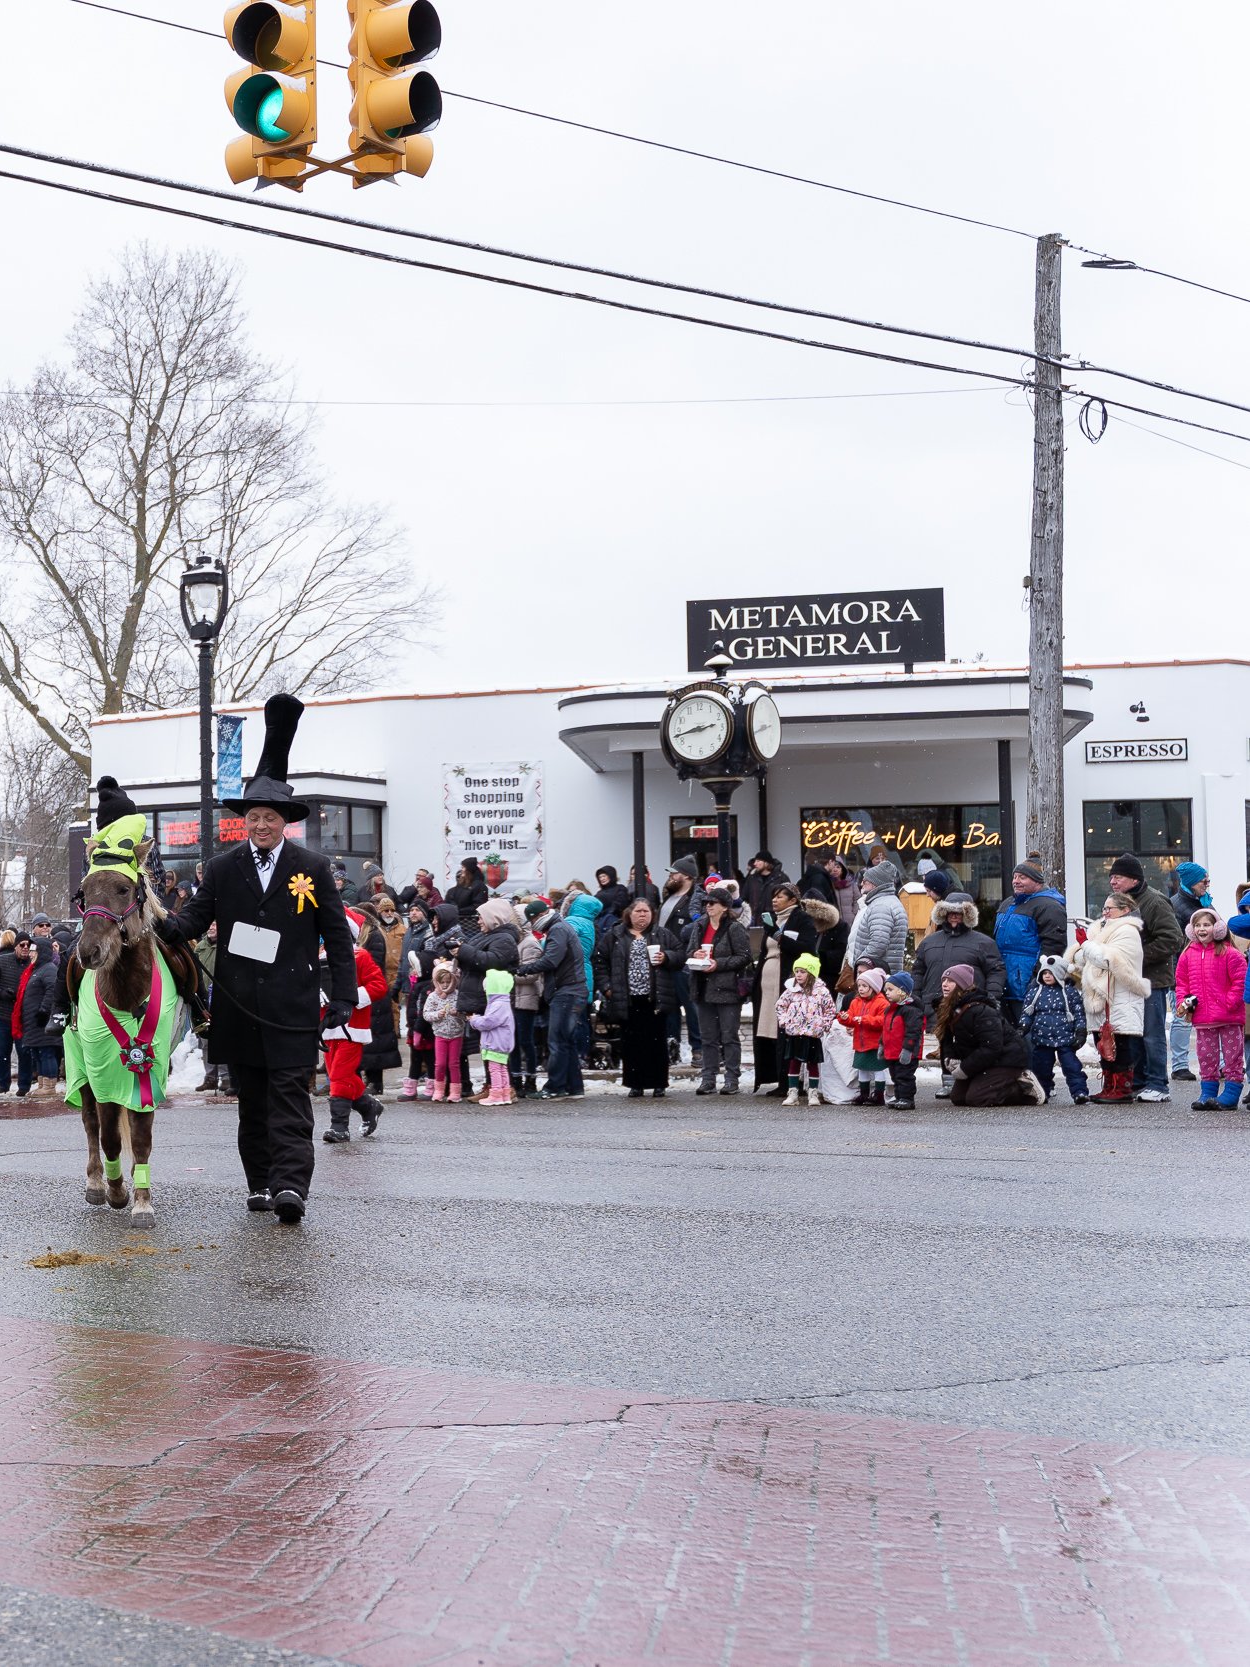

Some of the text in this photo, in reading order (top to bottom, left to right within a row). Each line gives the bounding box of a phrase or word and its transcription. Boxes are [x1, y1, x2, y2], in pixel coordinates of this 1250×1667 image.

[707, 599, 921, 631] METAMORA
[728, 631, 901, 660] GENERAL
[1091, 743, 1183, 758] ESPRESSO
[465, 777, 519, 787] One stop
[464, 792, 523, 803] shopping
[457, 809, 525, 819] for everyone
[164, 820, 200, 832] UNIQUE
[218, 818, 246, 830] BOOK
[469, 825, 513, 835] on your
[694, 828, 718, 838] OPEN
[803, 821, 876, 855] Coffee
[897, 824, 955, 850] Wine
[962, 823, 1002, 848] Ba
[459, 840, 496, 850] "nice"
